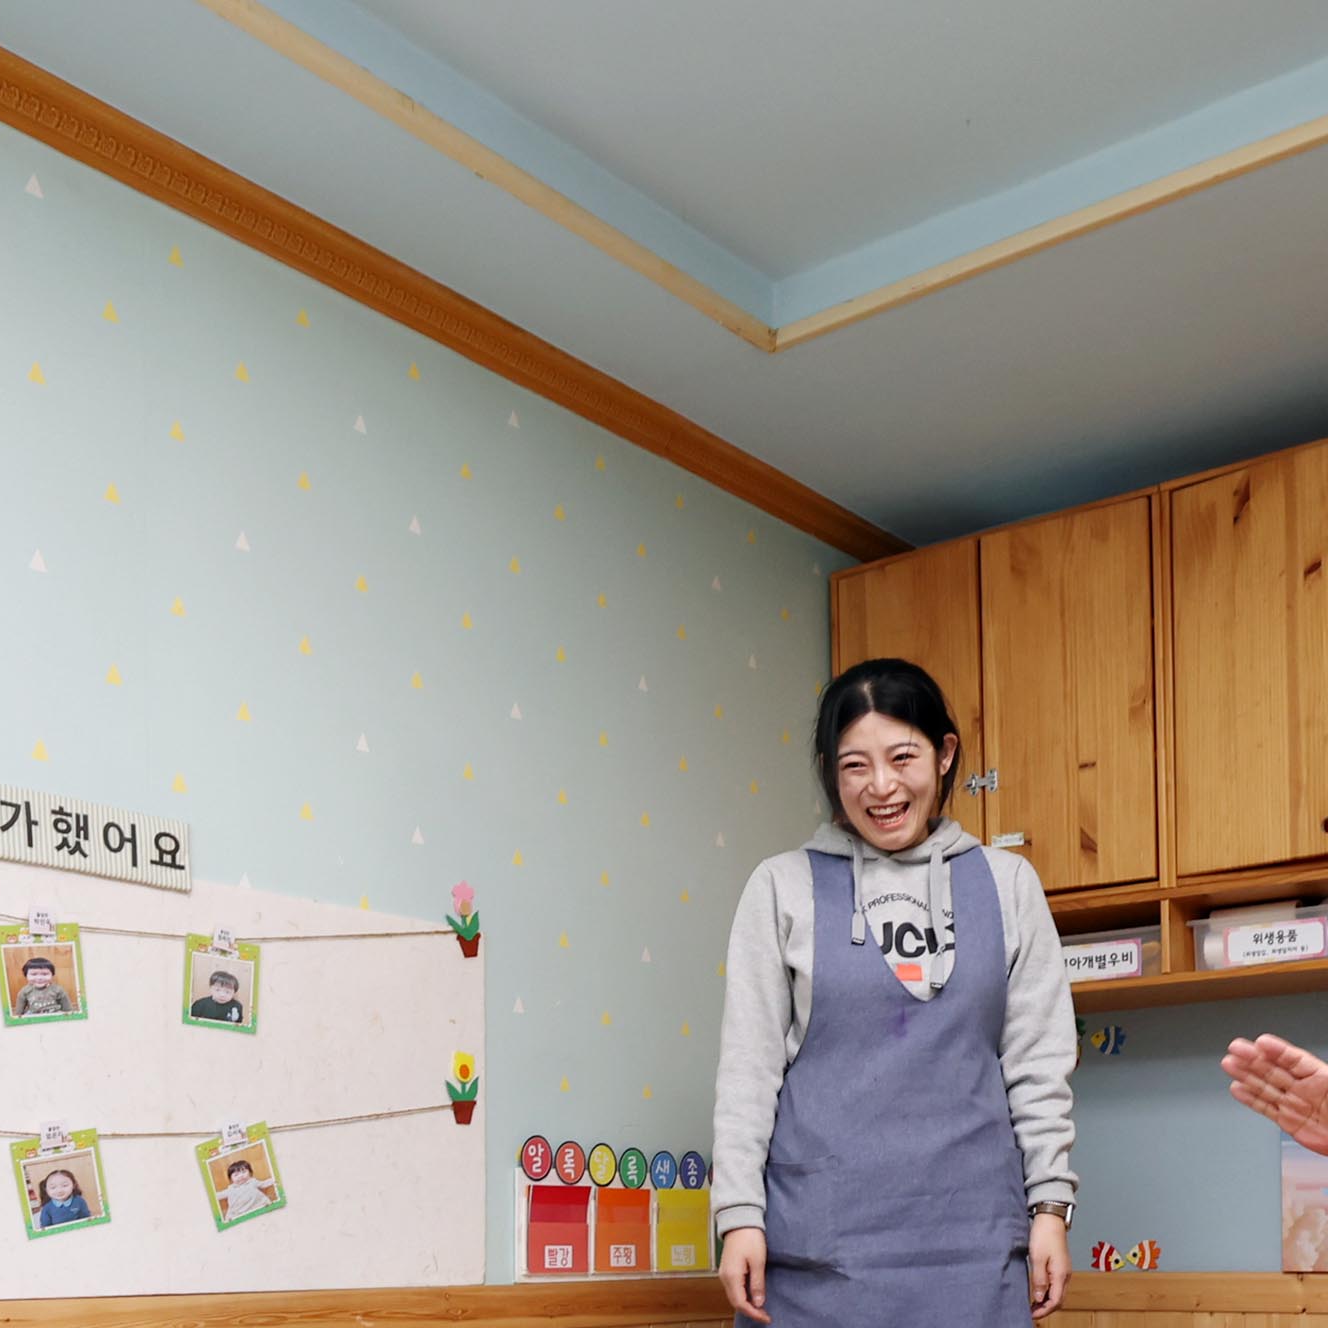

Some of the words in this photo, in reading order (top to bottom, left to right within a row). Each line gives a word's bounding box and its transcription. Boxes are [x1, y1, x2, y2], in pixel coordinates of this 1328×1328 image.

[1252, 929, 1299, 945] 위생용품
[527, 1142, 638, 1185] 알록달록
[655, 1157, 698, 1187] 색종
[548, 1247, 570, 1267] 빨강
[613, 1246, 633, 1265] 주황
